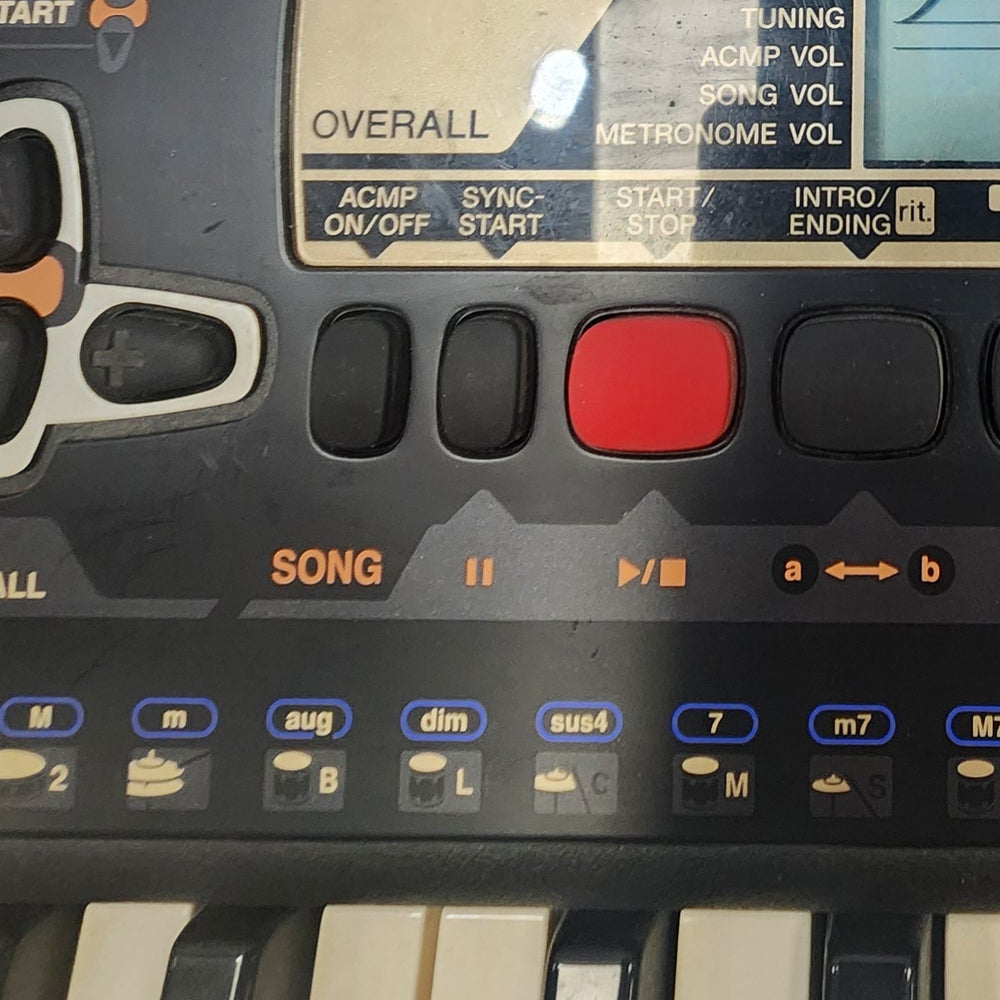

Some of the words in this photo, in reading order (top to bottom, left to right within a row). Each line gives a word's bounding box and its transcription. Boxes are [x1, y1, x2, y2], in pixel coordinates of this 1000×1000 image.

[740, 7, 844, 29] TUNING
[701, 46, 781, 67] ACMP
[791, 45, 843, 67] VOL
[699, 83, 777, 106] SONG
[790, 84, 843, 105] VOL
[313, 110, 488, 139] OVERALL
[596, 123, 776, 146] METRONOME
[790, 123, 842, 145] VOL
[339, 186, 417, 208] ACMP
[462, 186, 544, 208] SYNC-
[616, 186, 715, 208] START/
[796, 187, 890, 207] INTRO/
[325, 214, 431, 235] ON/OFF
[459, 213, 543, 235] START
[627, 213, 696, 235] STOP
[790, 214, 890, 235] ENDING
[272, 549, 382, 585] SONG
[785, 560, 801, 581] a
[922, 556, 940, 582] b
[285, 711, 333, 736] aug
[420, 708, 468, 733] dim
[549, 710, 610, 734] sus4
[709, 713, 723, 733] 7
[835, 714, 871, 735] m7
